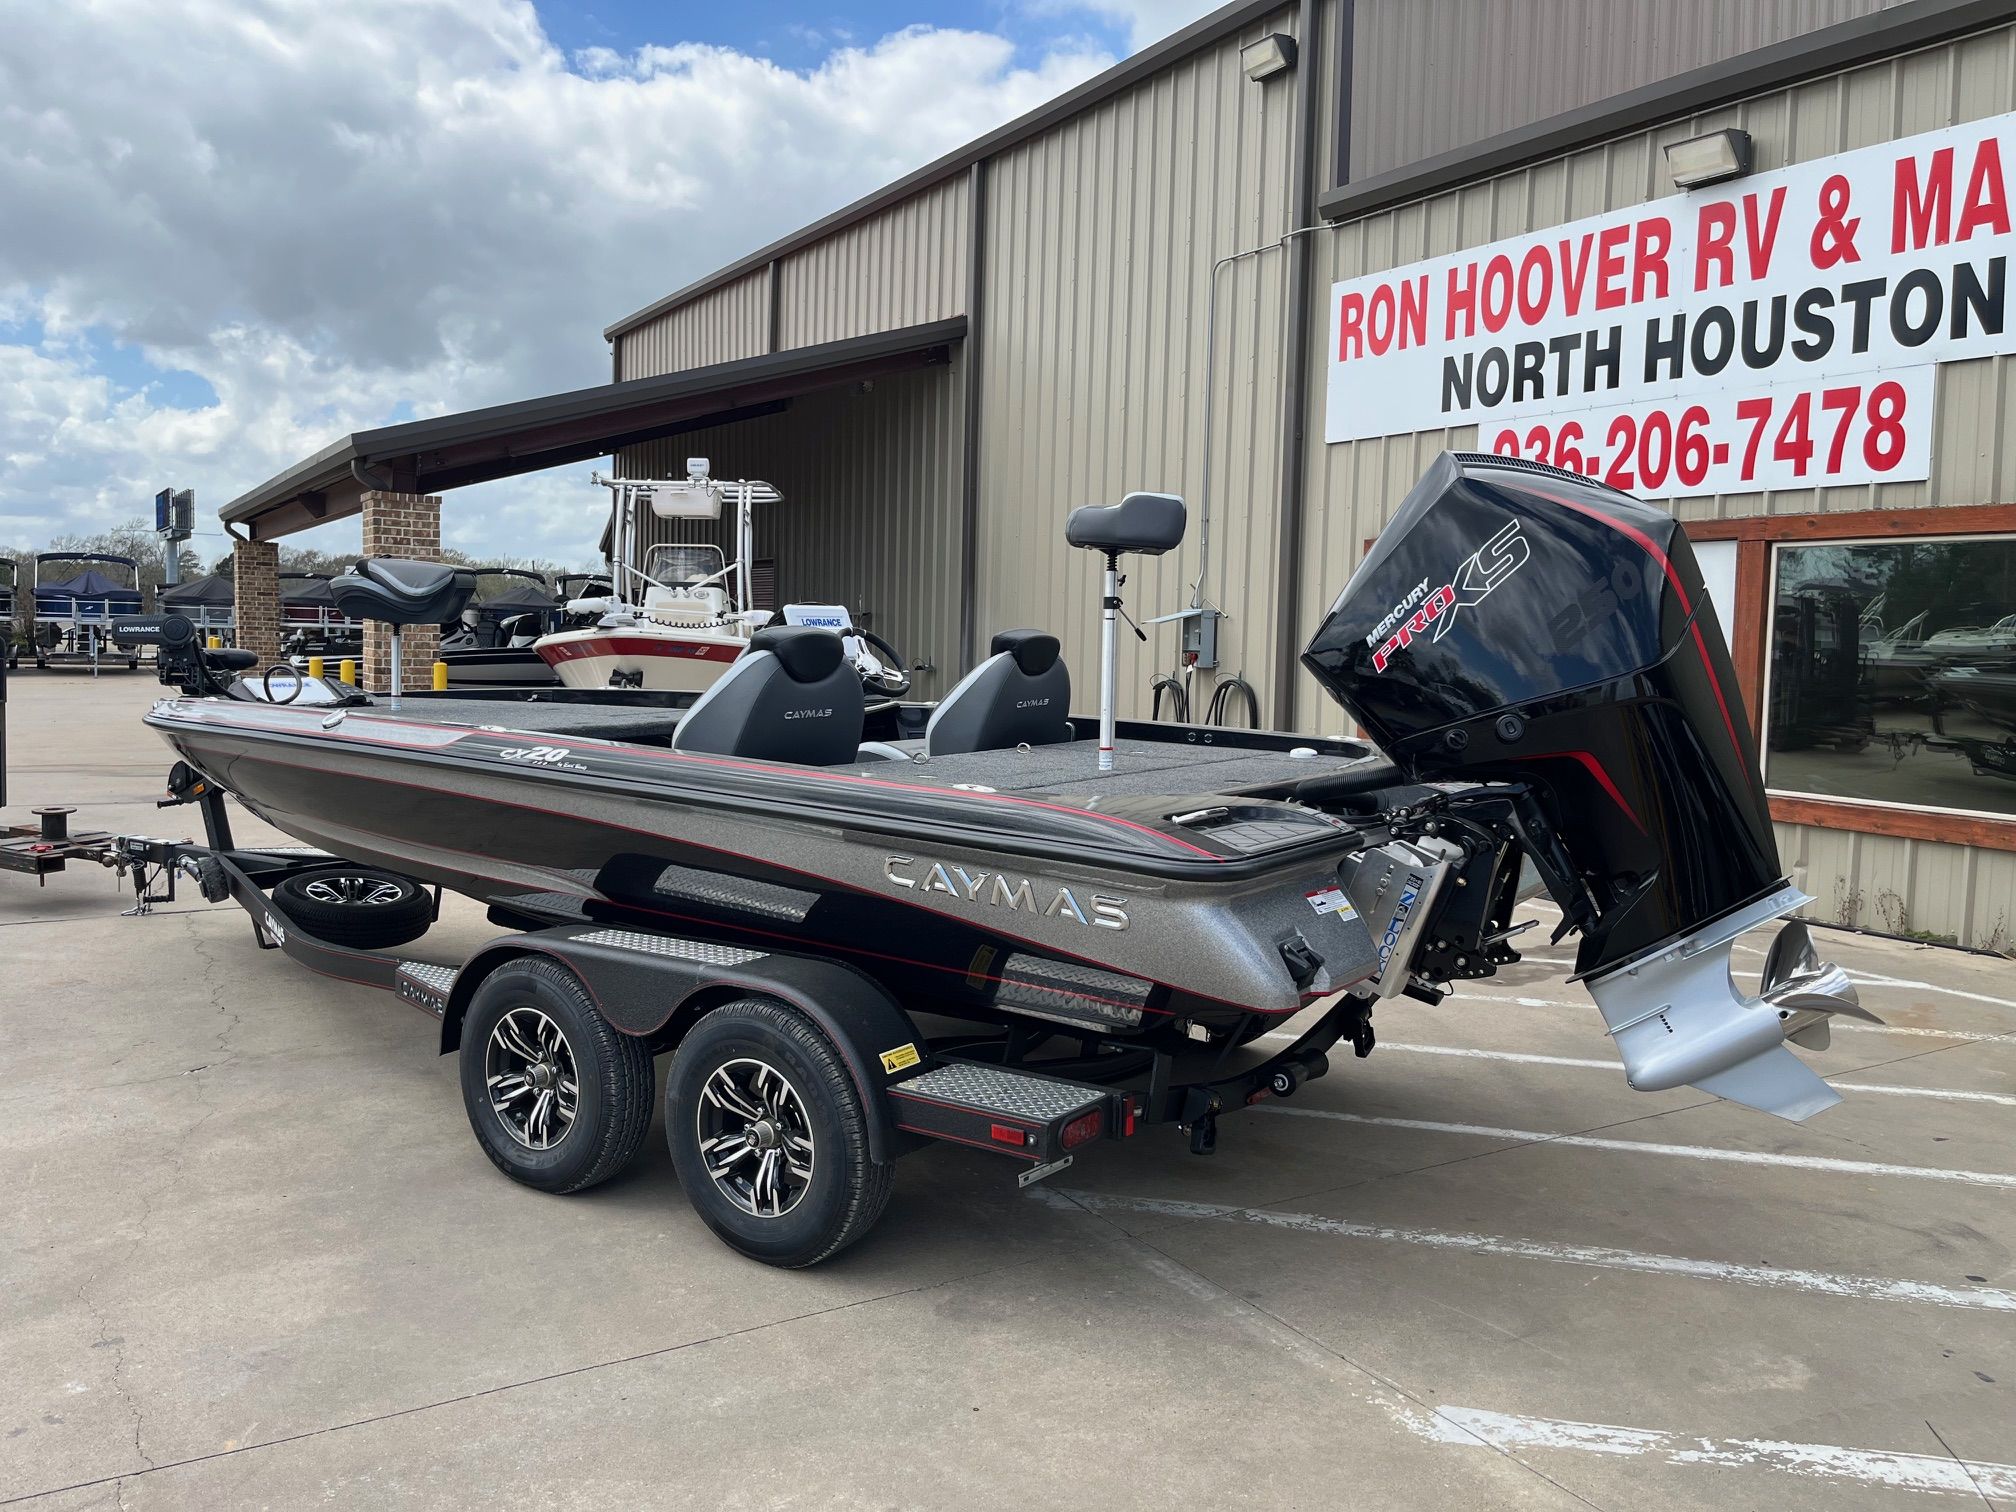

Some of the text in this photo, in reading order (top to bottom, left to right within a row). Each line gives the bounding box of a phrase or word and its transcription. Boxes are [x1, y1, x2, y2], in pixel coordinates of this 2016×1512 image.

[1339, 138, 2012, 362] RON HOOVER RV & MA
[1441, 255, 2007, 413] NORTH HOUSTON
[801, 618, 842, 627] LOWRANCE
[1365, 577, 1430, 648] MERCURY
[784, 708, 832, 719] CAYMAS
[1016, 698, 1049, 708] CAYMAS
[883, 854, 1131, 932] CAYMAS
[401, 981, 443, 1014] CAYMAS
